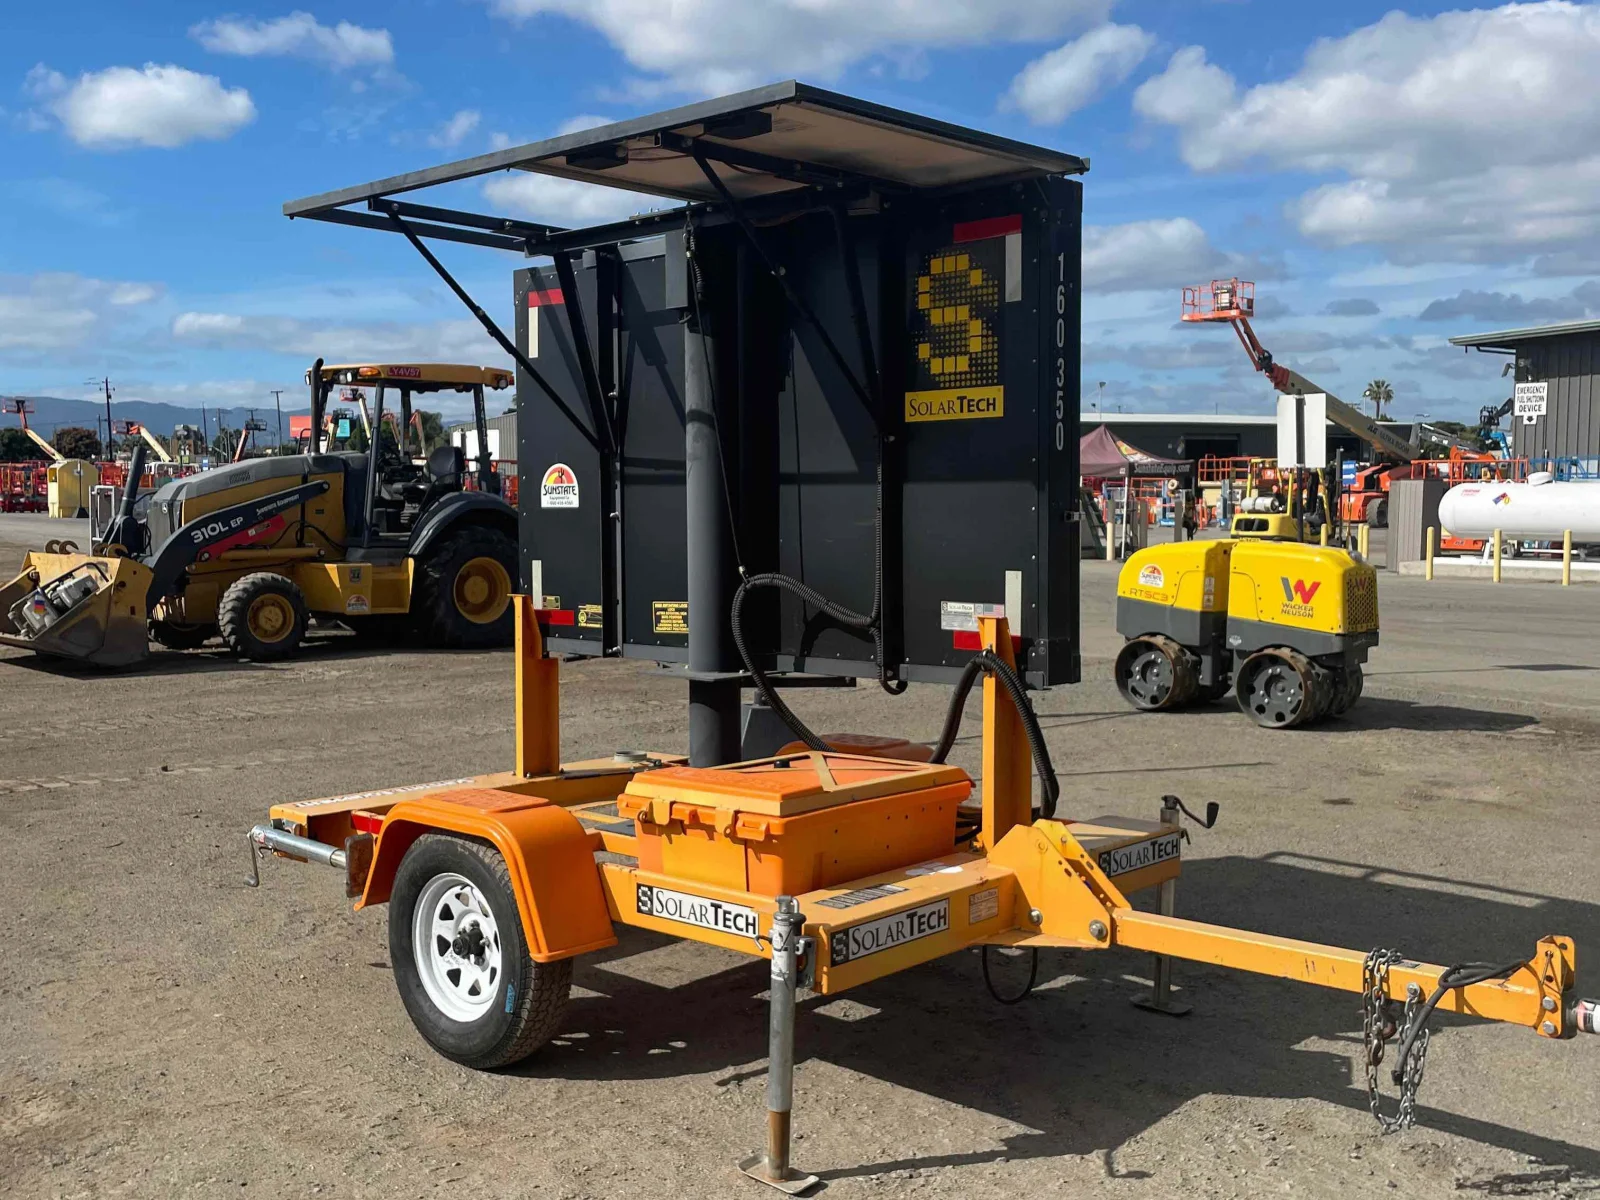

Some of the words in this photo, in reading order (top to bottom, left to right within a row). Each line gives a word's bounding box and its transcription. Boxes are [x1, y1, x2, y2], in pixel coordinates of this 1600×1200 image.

[1516, 386, 1546, 394] EMERGENCY
[1516, 395, 1525, 404] FUEL
[1518, 403, 1543, 413] DEVICE
[543, 484, 577, 496] SUNSTATE
[190, 521, 229, 543] 310L
[230, 516, 244, 528] EP
[1282, 602, 1314, 612] WACKER
[1281, 608, 1314, 619] NEUSON
